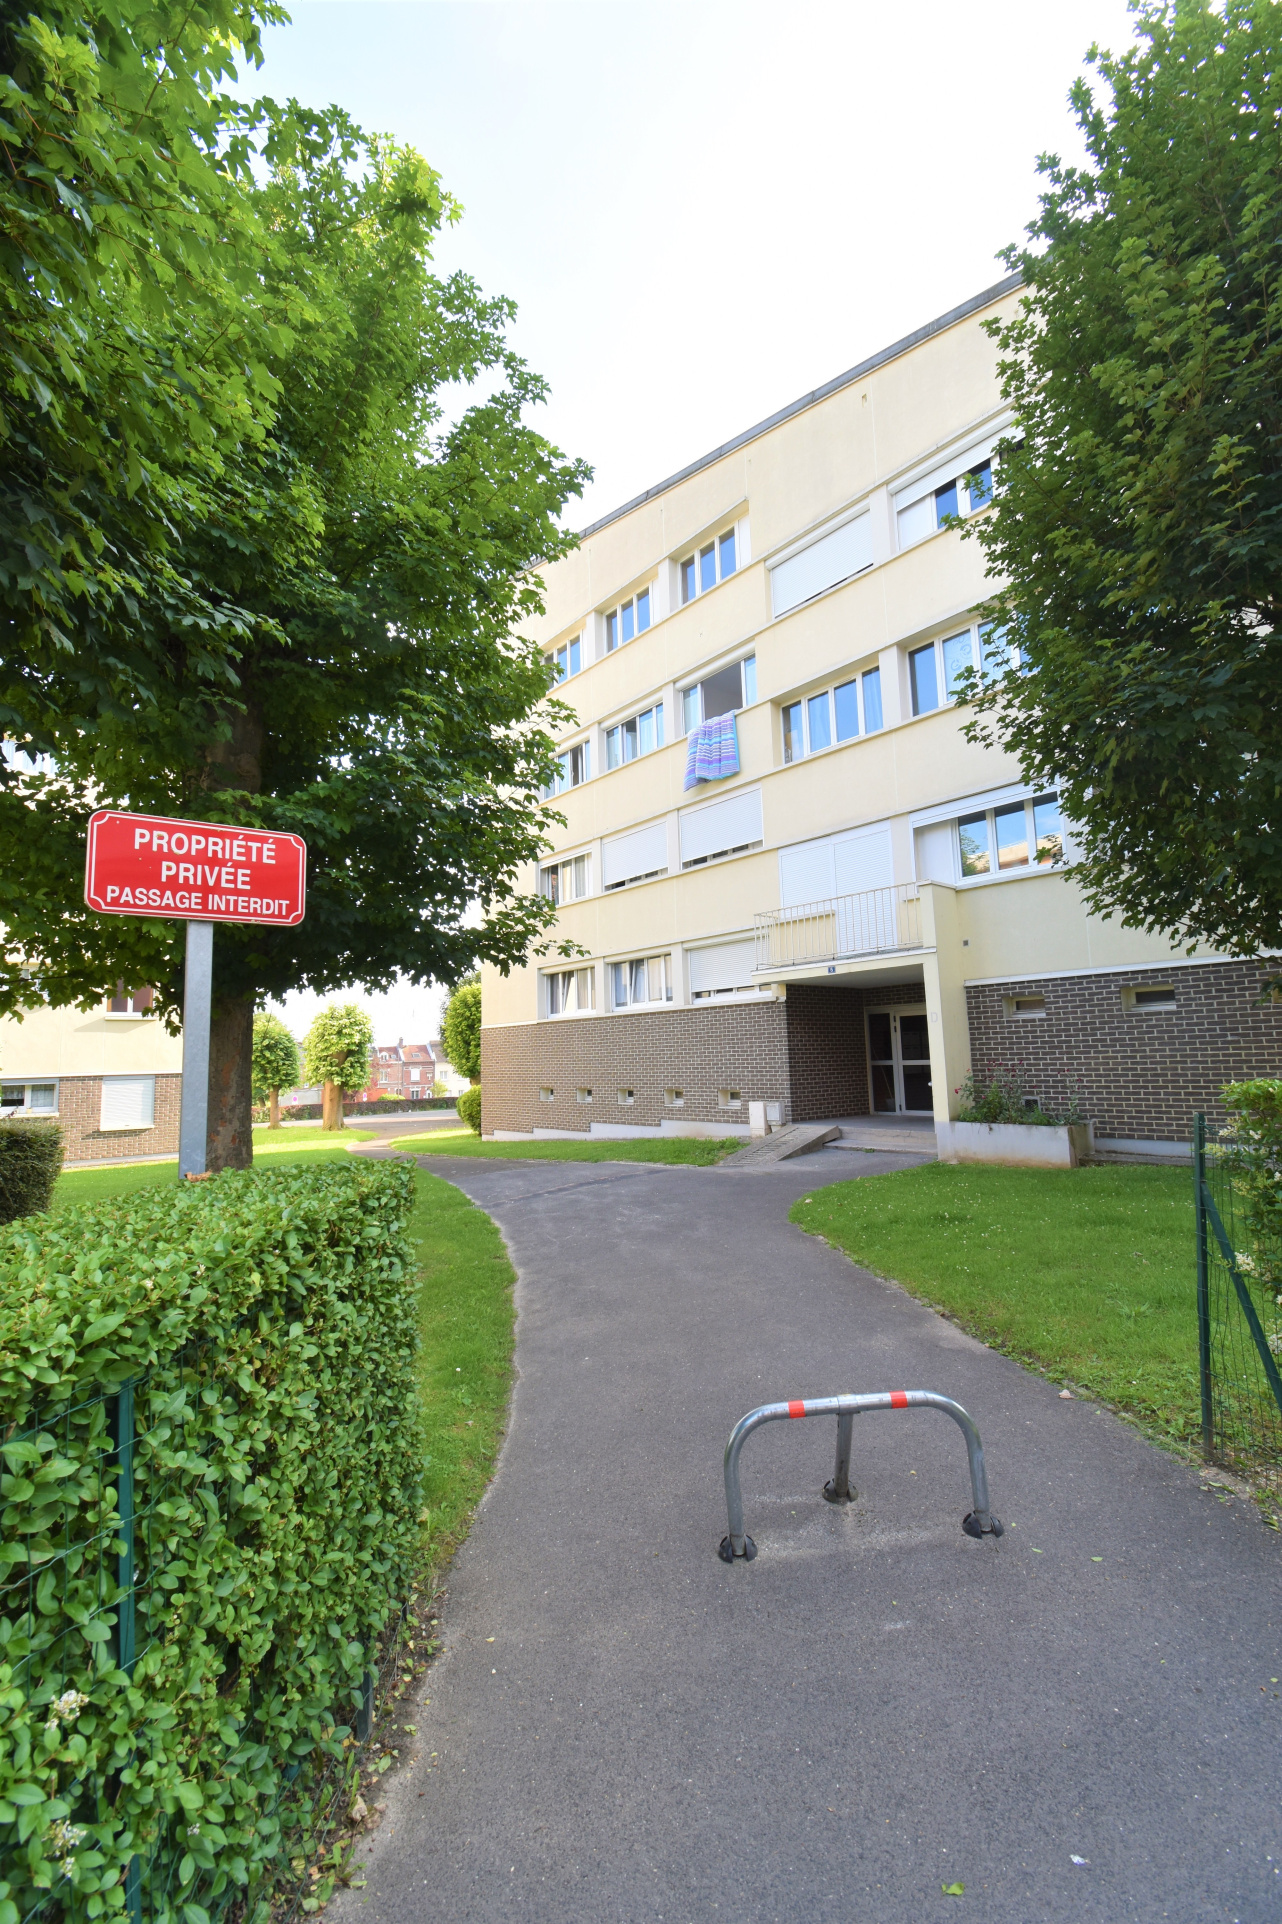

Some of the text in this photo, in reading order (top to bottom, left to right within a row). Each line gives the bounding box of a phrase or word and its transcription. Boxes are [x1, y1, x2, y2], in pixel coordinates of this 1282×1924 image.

[134, 828, 276, 865] PROPRIÉTÉ
[161, 861, 251, 890] PRIVÉE
[106, 885, 290, 916] PASSAGE INTERDIT
